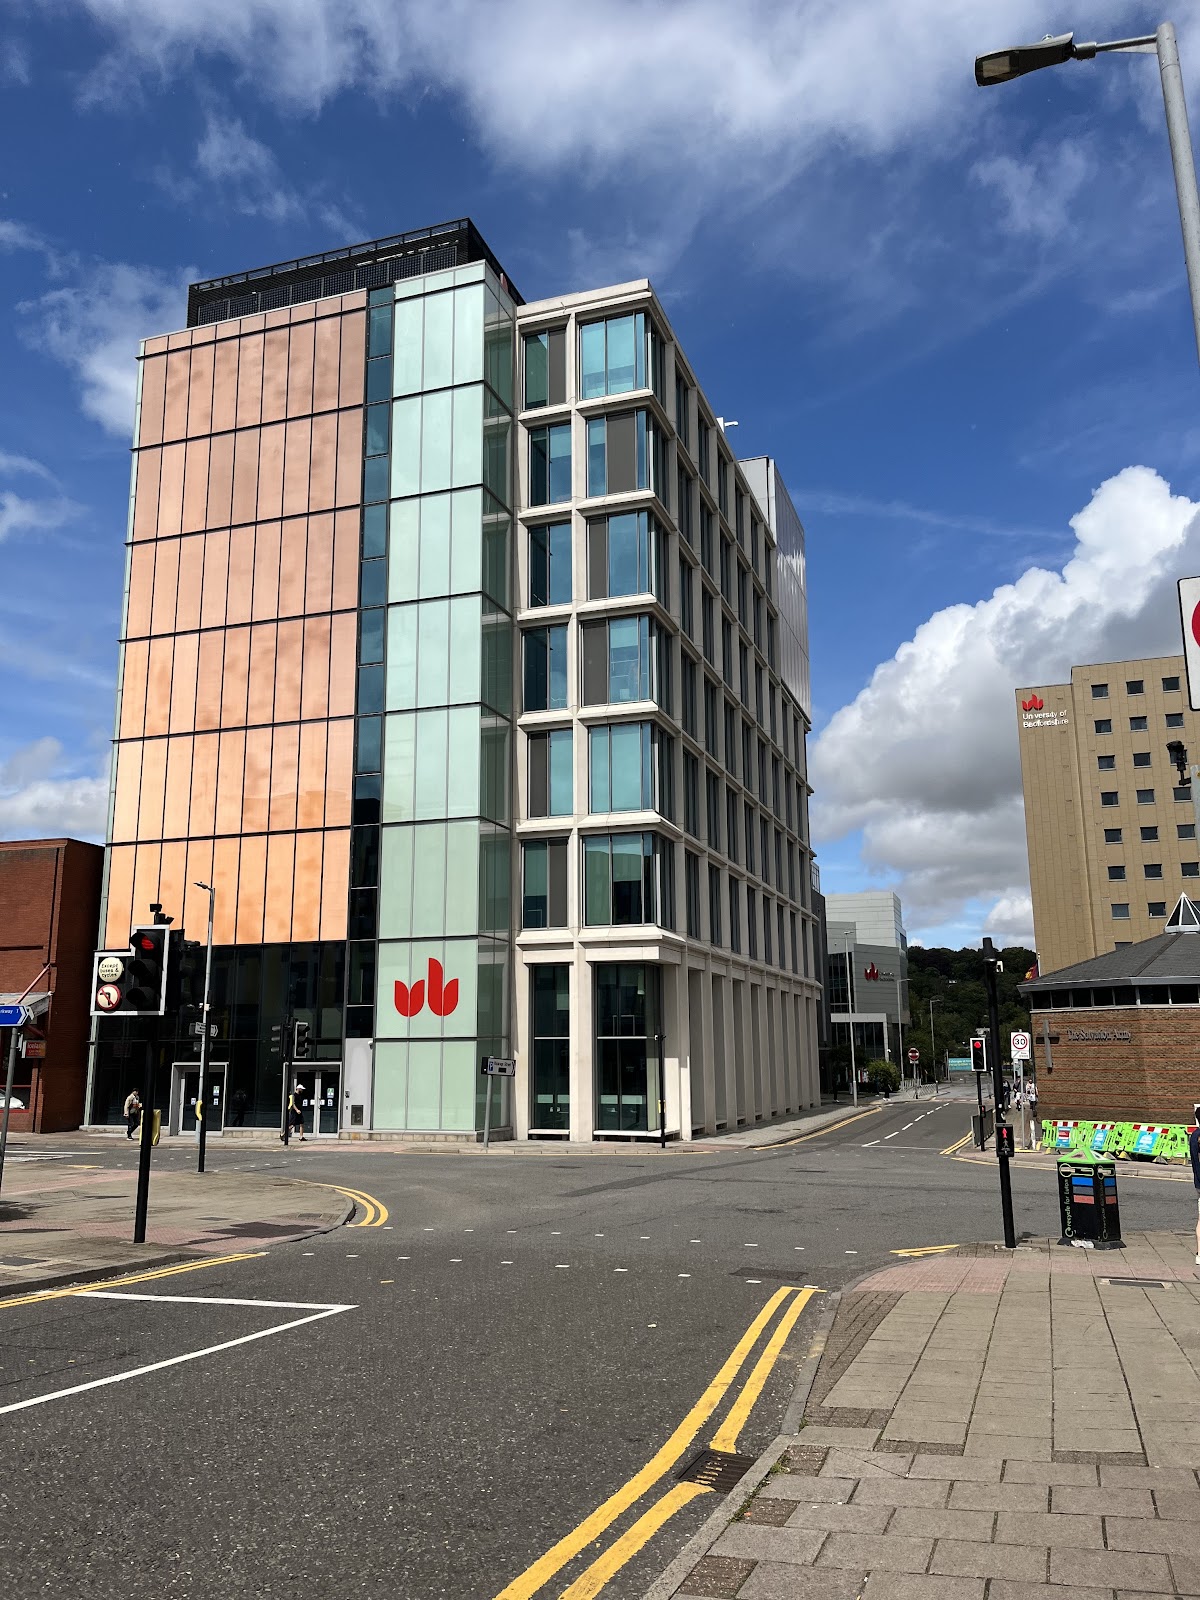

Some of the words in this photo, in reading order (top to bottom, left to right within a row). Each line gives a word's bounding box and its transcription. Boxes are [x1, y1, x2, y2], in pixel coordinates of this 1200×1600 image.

[1022, 718, 1069, 728] Bedfordshire
[1014, 1038, 1026, 1046] 30
[1064, 1205, 1073, 1227] recycle
